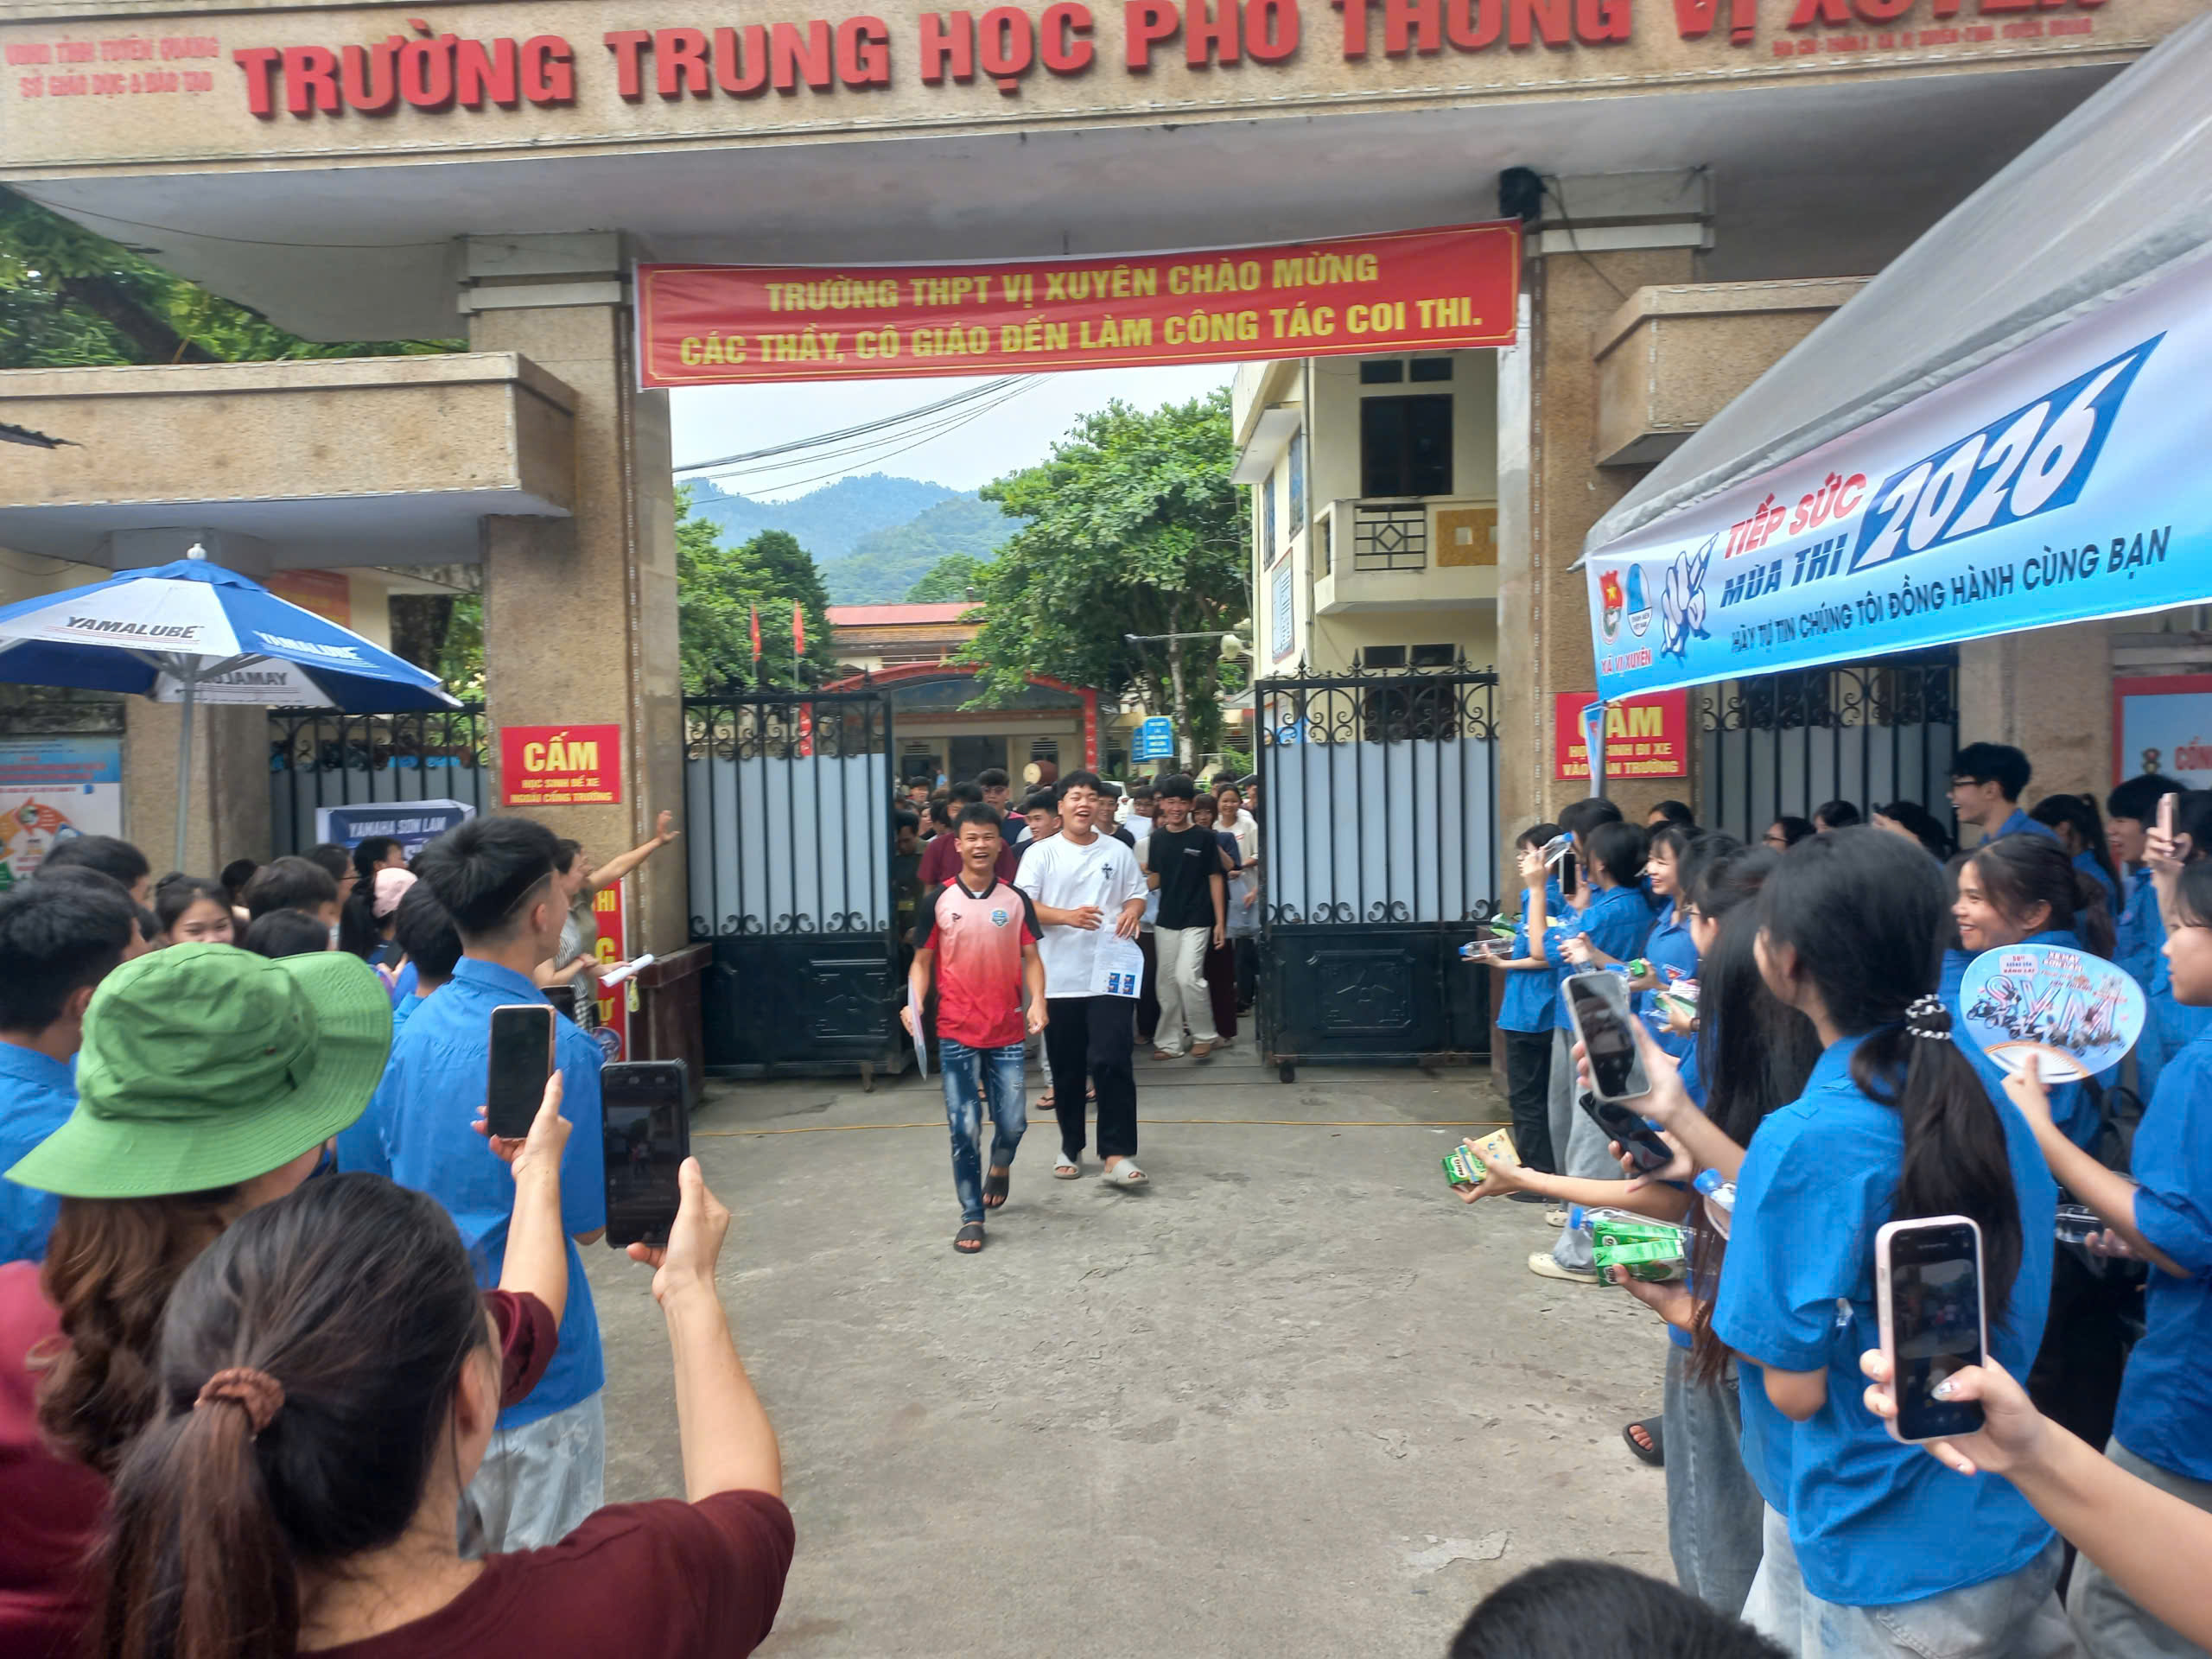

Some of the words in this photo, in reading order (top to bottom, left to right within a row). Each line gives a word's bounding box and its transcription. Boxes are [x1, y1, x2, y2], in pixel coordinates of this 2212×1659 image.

[234, 19, 575, 118] TRƯỜNG
[604, 15, 891, 100] TRUNG
[919, 1, 1094, 93] HỌC
[765, 275, 899, 312] TRƯỜNG
[909, 275, 992, 307] THPT
[1002, 273, 1034, 309] VỊ
[1046, 264, 1157, 301] XUYÊN
[1168, 257, 1260, 294] CHÀO
[1272, 251, 1379, 289] MỪNG
[680, 330, 747, 366] CÁC
[855, 324, 900, 359] CÔ
[911, 321, 989, 357] GIÁO
[1001, 314, 1069, 353] ĐẾN
[1079, 314, 1153, 349] LÀM
[1164, 308, 1259, 344] CÔNG
[1268, 301, 1335, 339] TÁC
[1346, 302, 1406, 334] COI
[1416, 296, 1483, 329] THI.
[1719, 559, 1783, 608] MÙA
[1790, 532, 1848, 588] THI
[1853, 353, 2140, 569] 2026
[1724, 492, 1787, 560] TIẾP
[1789, 472, 1867, 536] SỨC
[1775, 617, 1796, 644] TIN
[1799, 601, 1853, 639] CHÚNG
[1856, 590, 1884, 626] TÔI
[1888, 574, 1946, 620] ĐỒNG
[1951, 564, 2014, 607] HÀNH
[2023, 544, 2100, 591] CÙNG
[2107, 525, 2172, 580] BẠN
[67, 616, 201, 639] YAMALUBE
[1625, 647, 1651, 670] XUYÊN
[524, 731, 598, 772] CẤM
[1653, 742, 1673, 755] XE
[586, 777, 601, 787] XE
